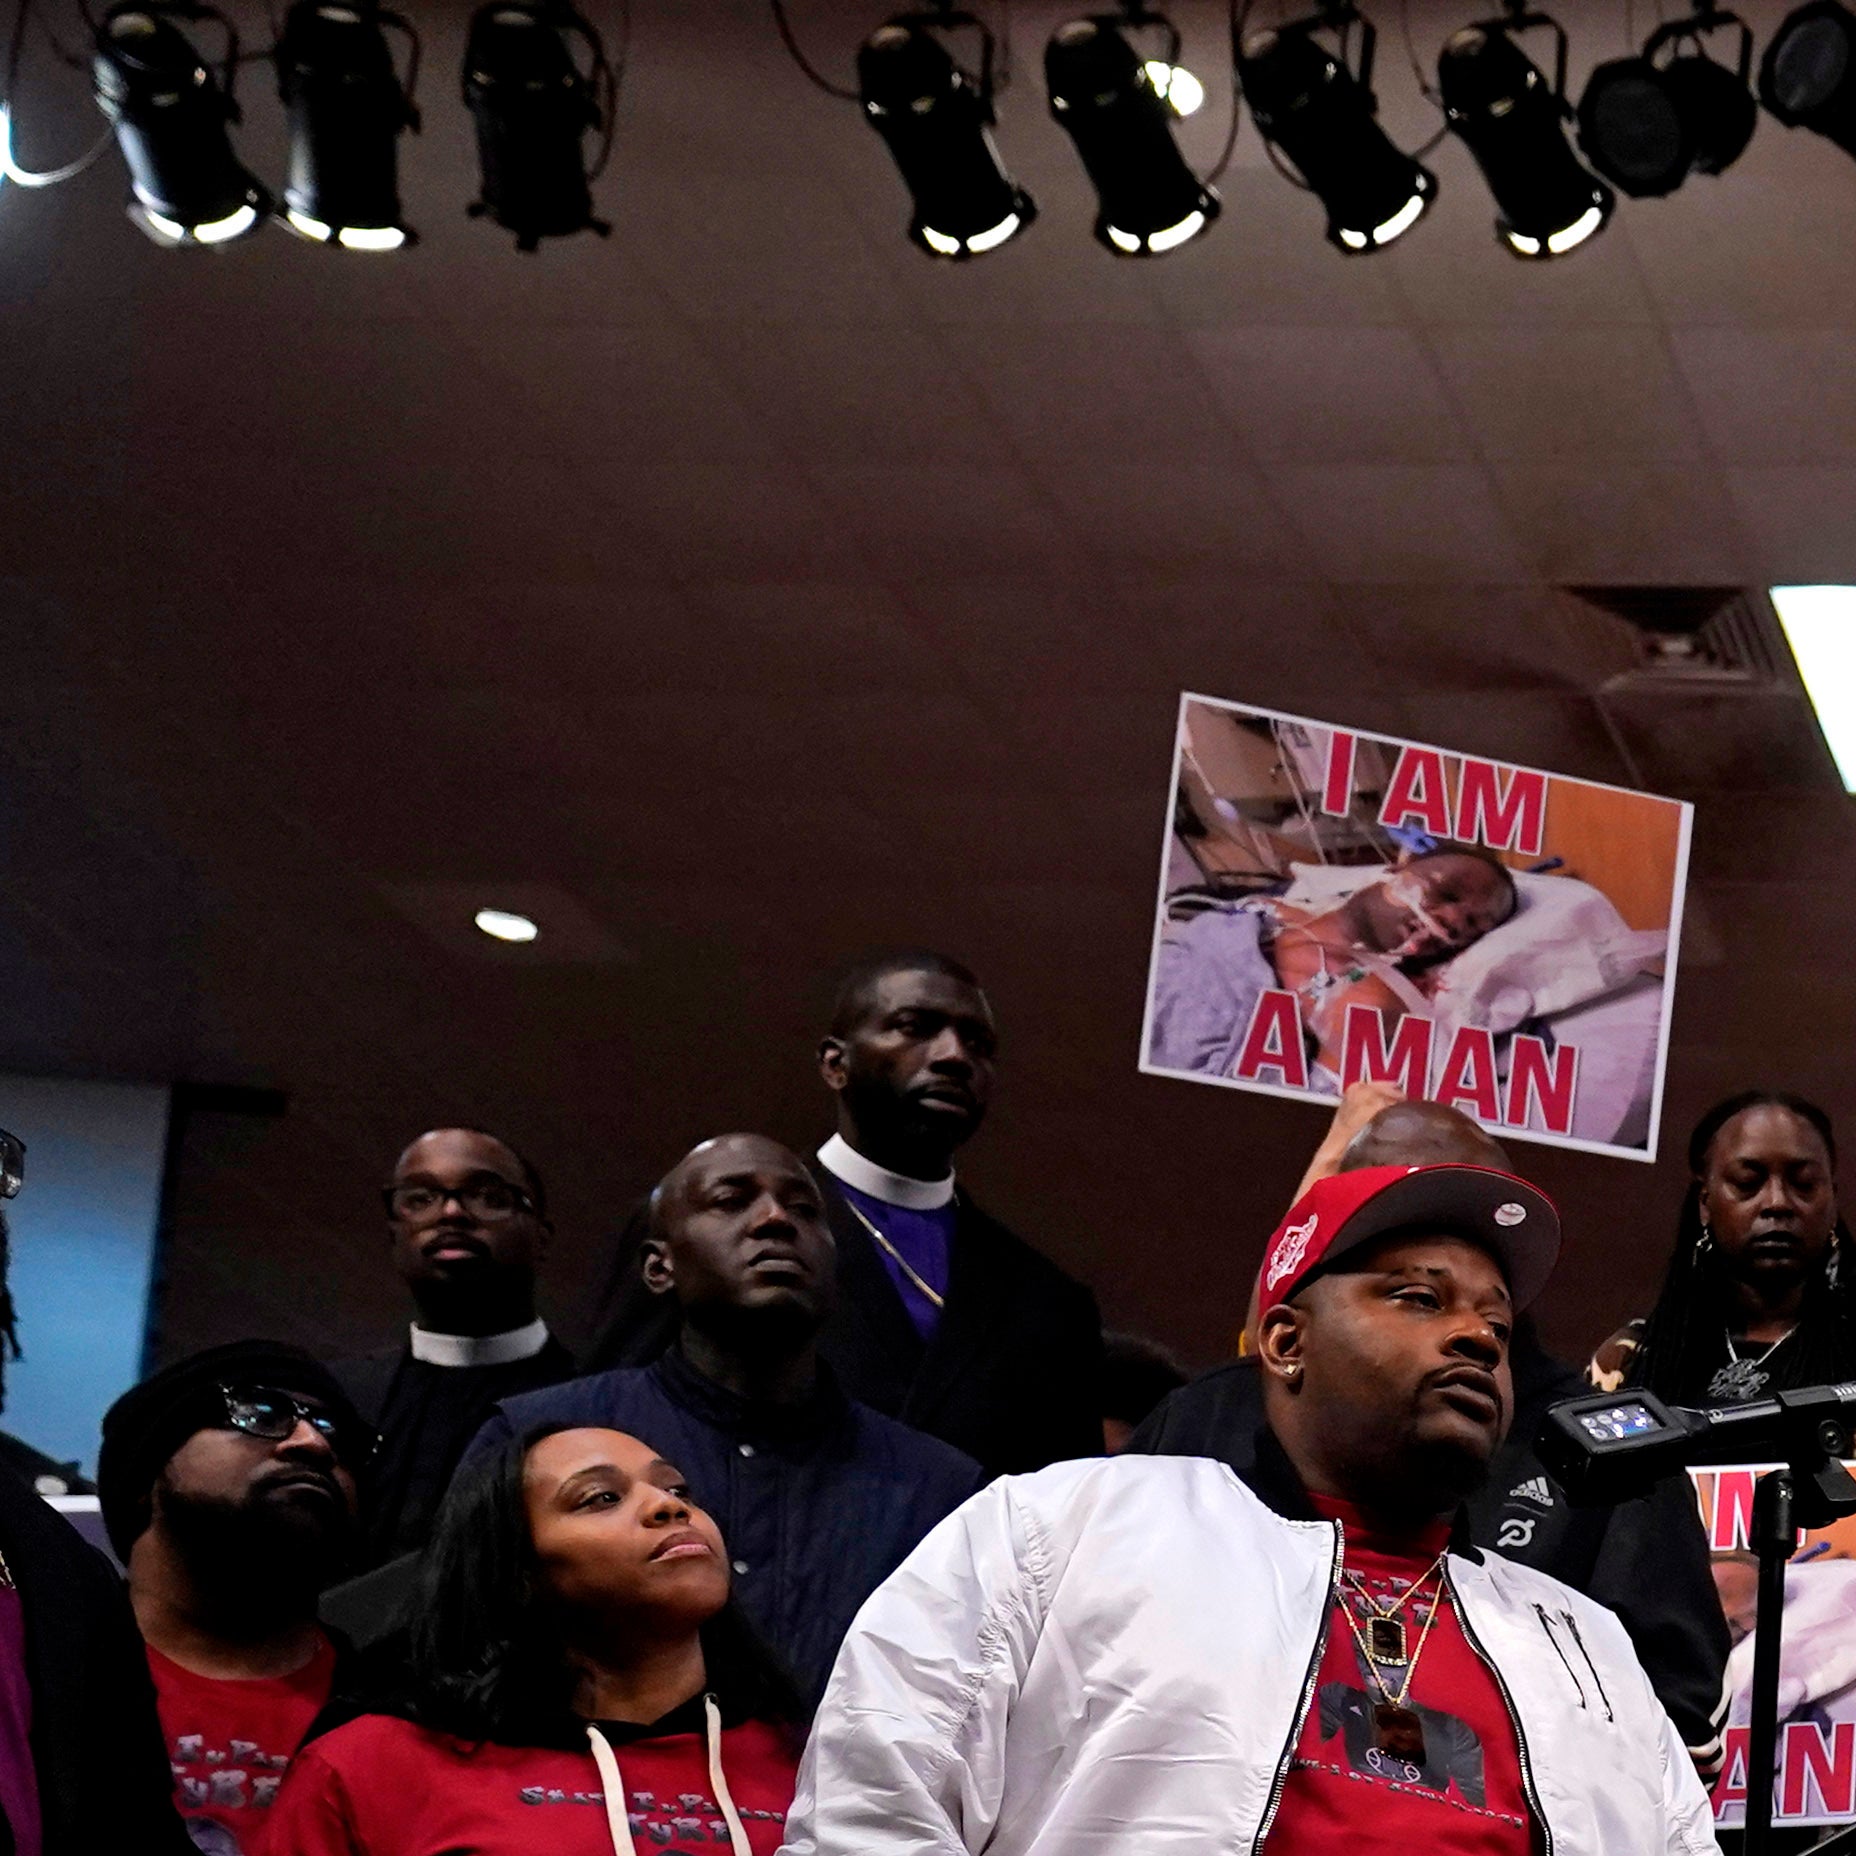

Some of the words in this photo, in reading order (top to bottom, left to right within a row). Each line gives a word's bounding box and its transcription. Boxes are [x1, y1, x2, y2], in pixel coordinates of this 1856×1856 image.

[1321, 730, 1356, 818] I
[1379, 745, 1548, 856] AM
[1233, 988, 1310, 1088] A
[1337, 1003, 1579, 1136] MAN
[1509, 1487, 1555, 1508] adidas
